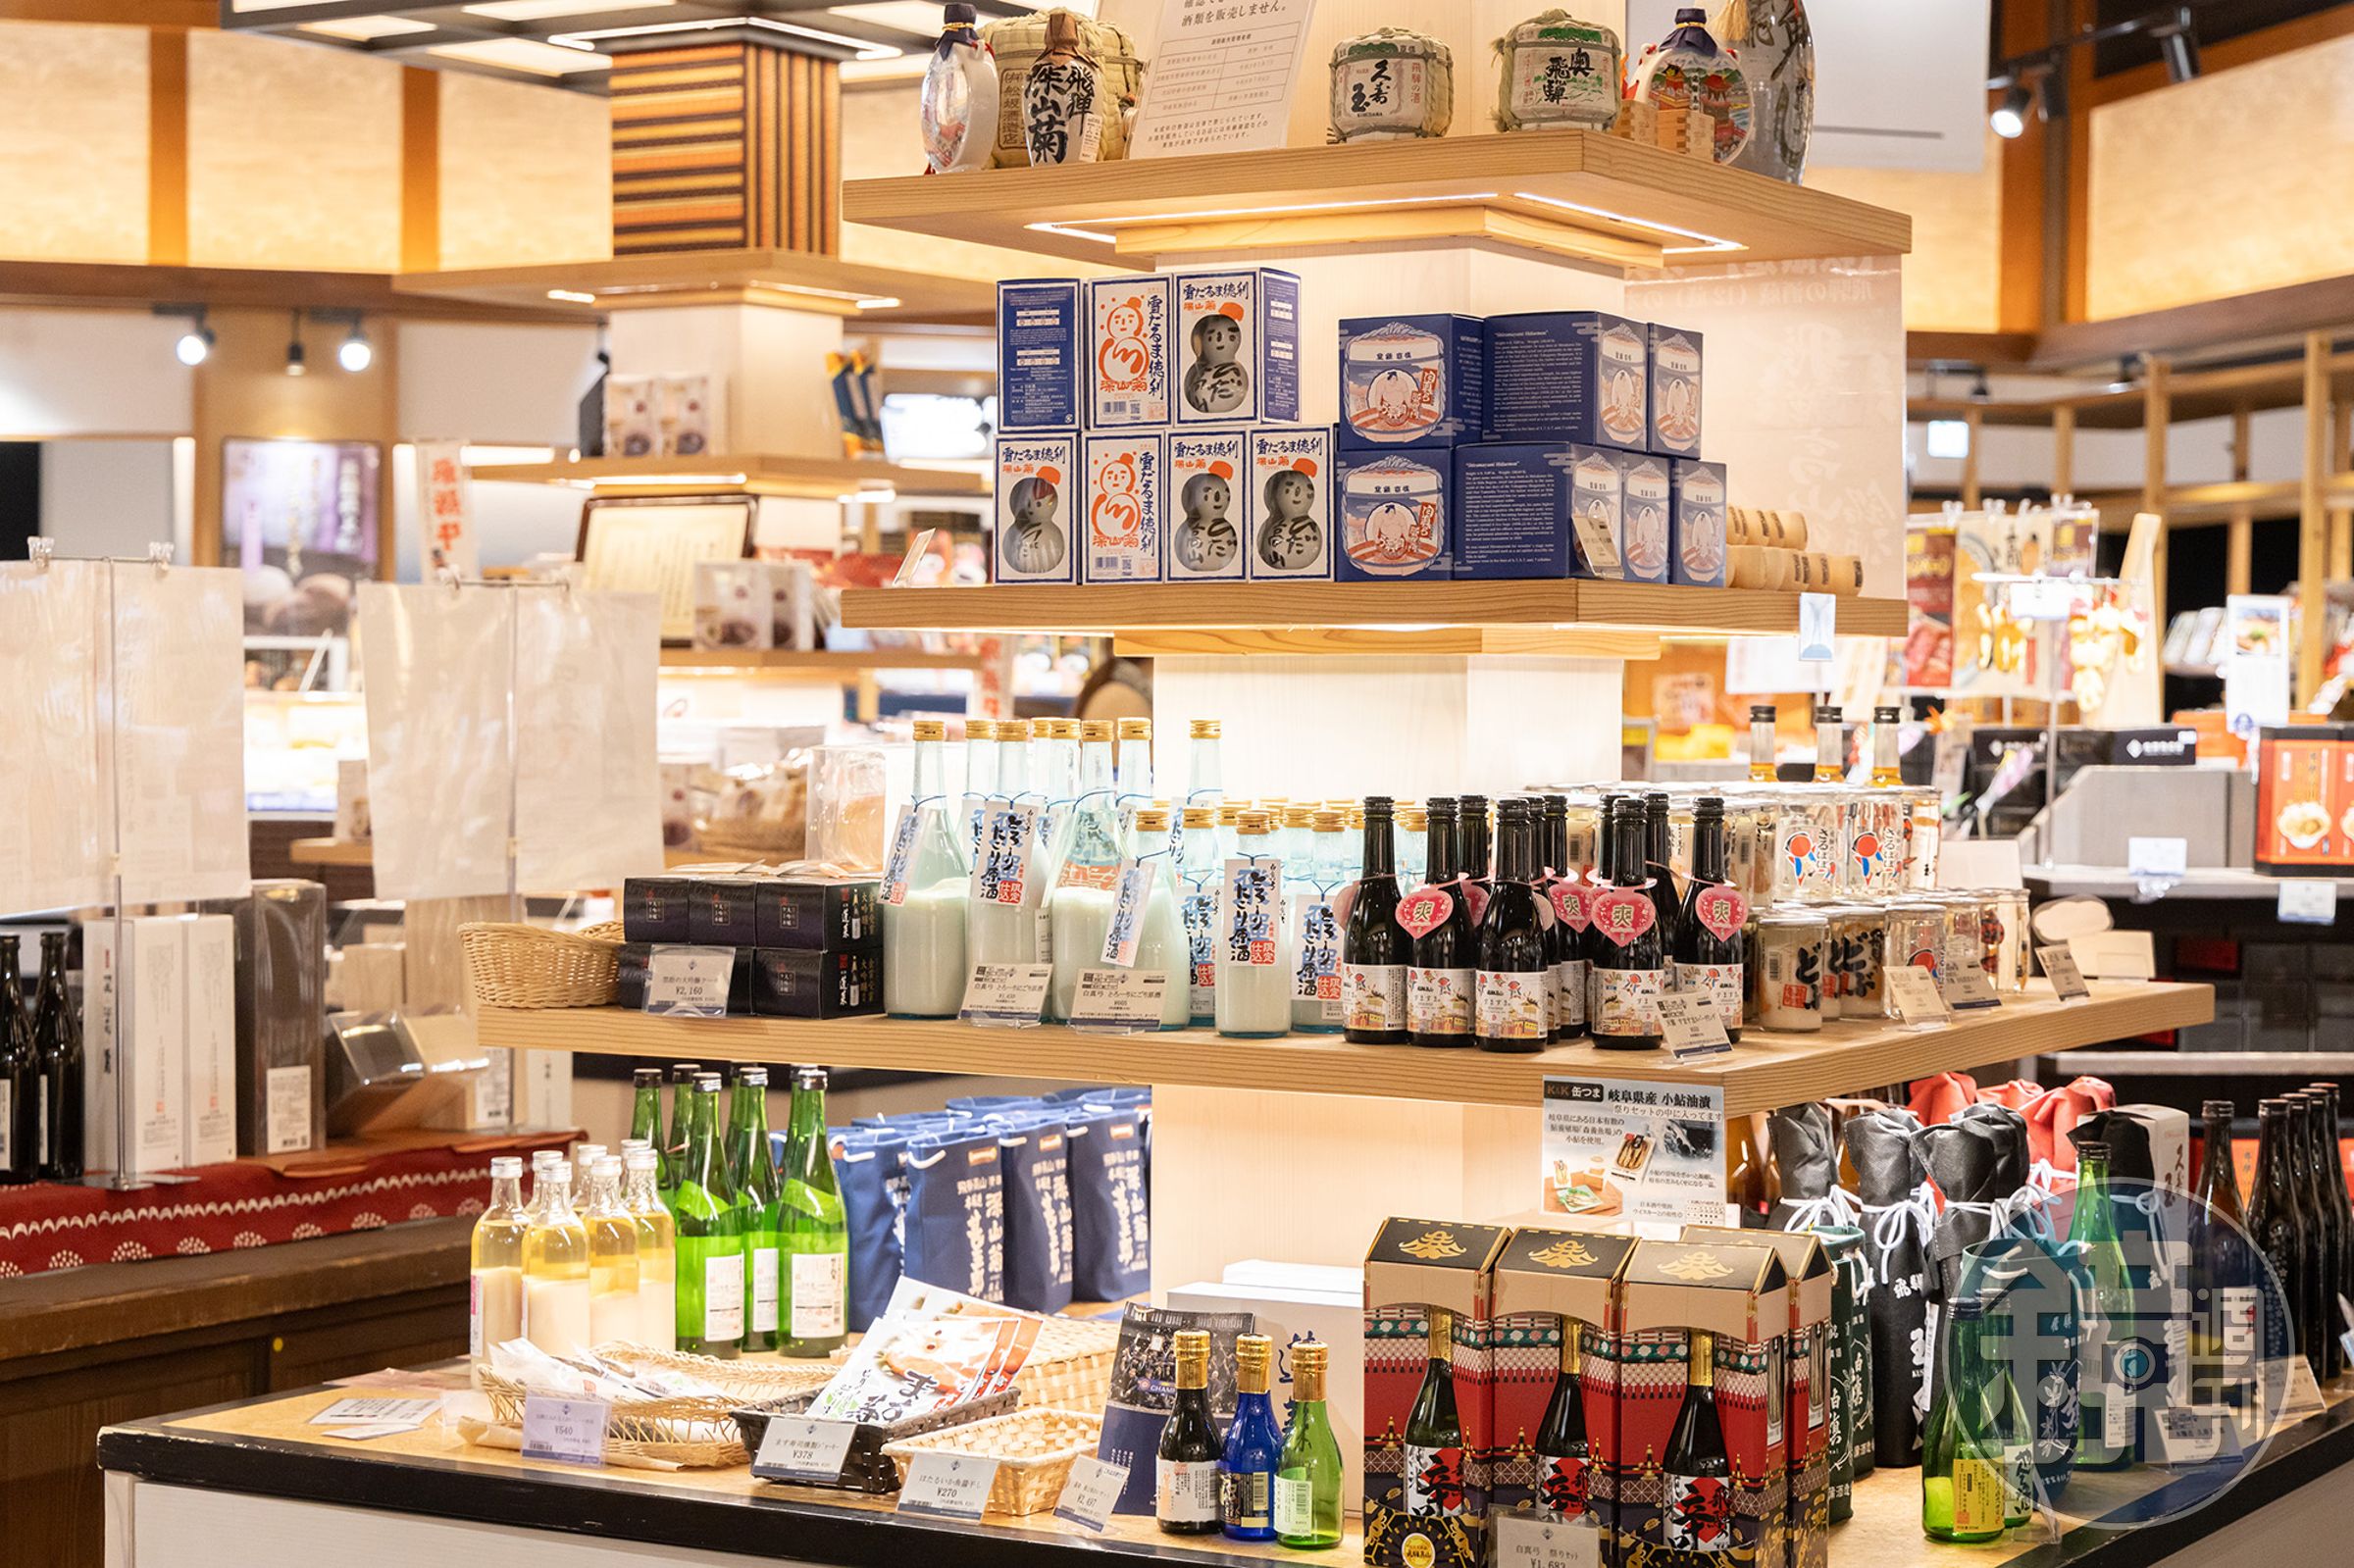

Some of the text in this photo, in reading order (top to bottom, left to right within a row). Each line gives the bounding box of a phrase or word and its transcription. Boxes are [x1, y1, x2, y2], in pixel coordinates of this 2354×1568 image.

[1024, 62, 1068, 164] 深山菊
[1183, 281, 1250, 300] 雪だるま徳利
[1148, 294, 1165, 400] 雪だるま徳利
[1002, 446, 1066, 465] 雪だるま徳利
[1175, 440, 1239, 459] 雪だるま徳利
[1256, 437, 1323, 456] 雪だるま徳利
[1140, 451, 1156, 557] 雪だるま徳利
[1571, 1087, 1601, 1097] 缶つま
[1608, 1089, 1658, 1105] 岐阜県産
[1662, 1092, 1712, 1109] 小鮎油漬
[1614, 1104, 1721, 1122] 祭りセットの中に入ってます
[553, 1425, 574, 1436] ¥540
[793, 1450, 814, 1459] ¥378
[937, 1487, 958, 1498] ¥270
[1516, 1544, 1541, 1555] 白真弓
